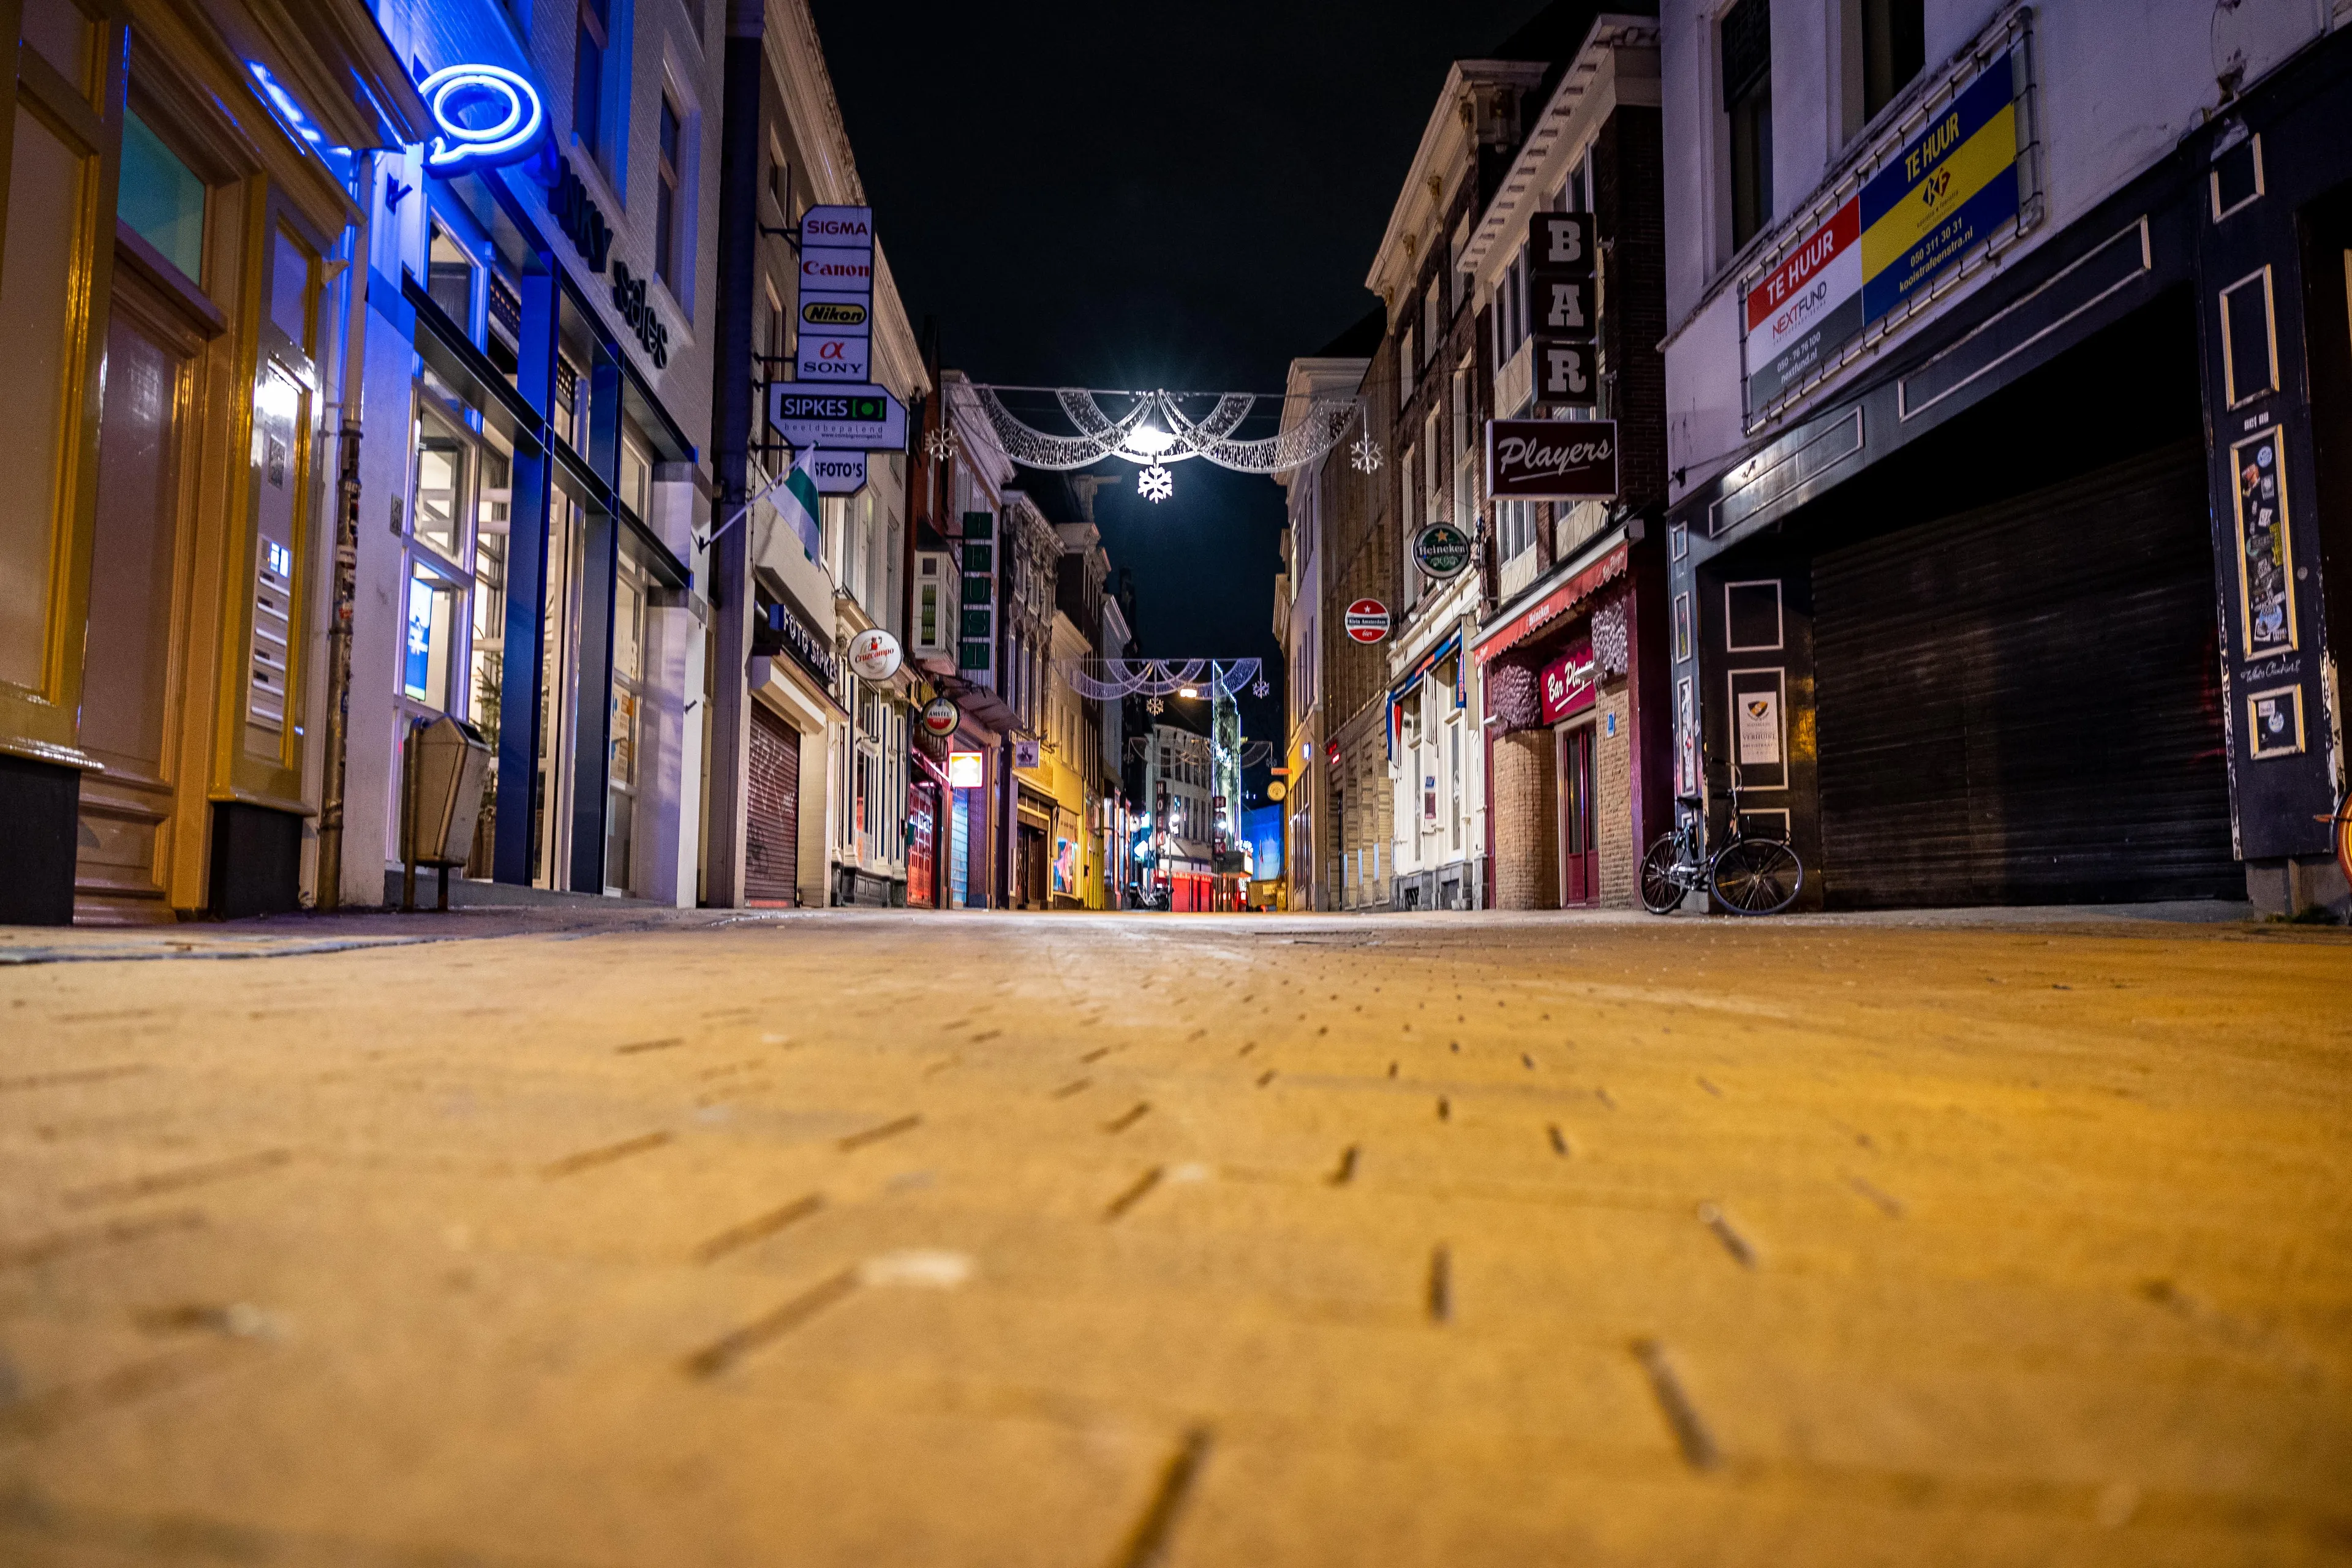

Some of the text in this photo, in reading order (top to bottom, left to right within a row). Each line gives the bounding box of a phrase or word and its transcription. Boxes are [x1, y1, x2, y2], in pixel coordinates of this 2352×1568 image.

[1905, 111, 1959, 183] TE HUUR
[807, 220, 869, 236] SIGMA
[1910, 248, 1924, 268] 050
[1926, 235, 1939, 255] 311
[1941, 225, 1951, 243] 30
[1953, 216, 1962, 234] 31
[802, 260, 870, 277] Canon
[1767, 229, 1834, 306] TE HUUR
[1899, 225, 1973, 293] kooistrafeenstra.nl
[613, 260, 668, 369] Sales
[809, 306, 863, 322] Nikon
[1548, 219, 1588, 394] BAR
[1773, 281, 1827, 339] NEXTFUND
[804, 361, 864, 374] SONY
[1777, 359, 1789, 372] 050
[1792, 348, 1800, 361] 76
[1801, 339, 1809, 353] 76
[1810, 331, 1821, 346] 100
[1781, 347, 1818, 385] nextfund.nl
[784, 398, 848, 417] SIPKES
[1498, 436, 1613, 476] Players
[1419, 543, 1466, 556] Heineken
[783, 605, 838, 685] FOTO SIPKES
[854, 648, 894, 663] Cruzcampo
[1548, 673, 1564, 703] Bar
[1156, 782, 1165, 845] HOEK
